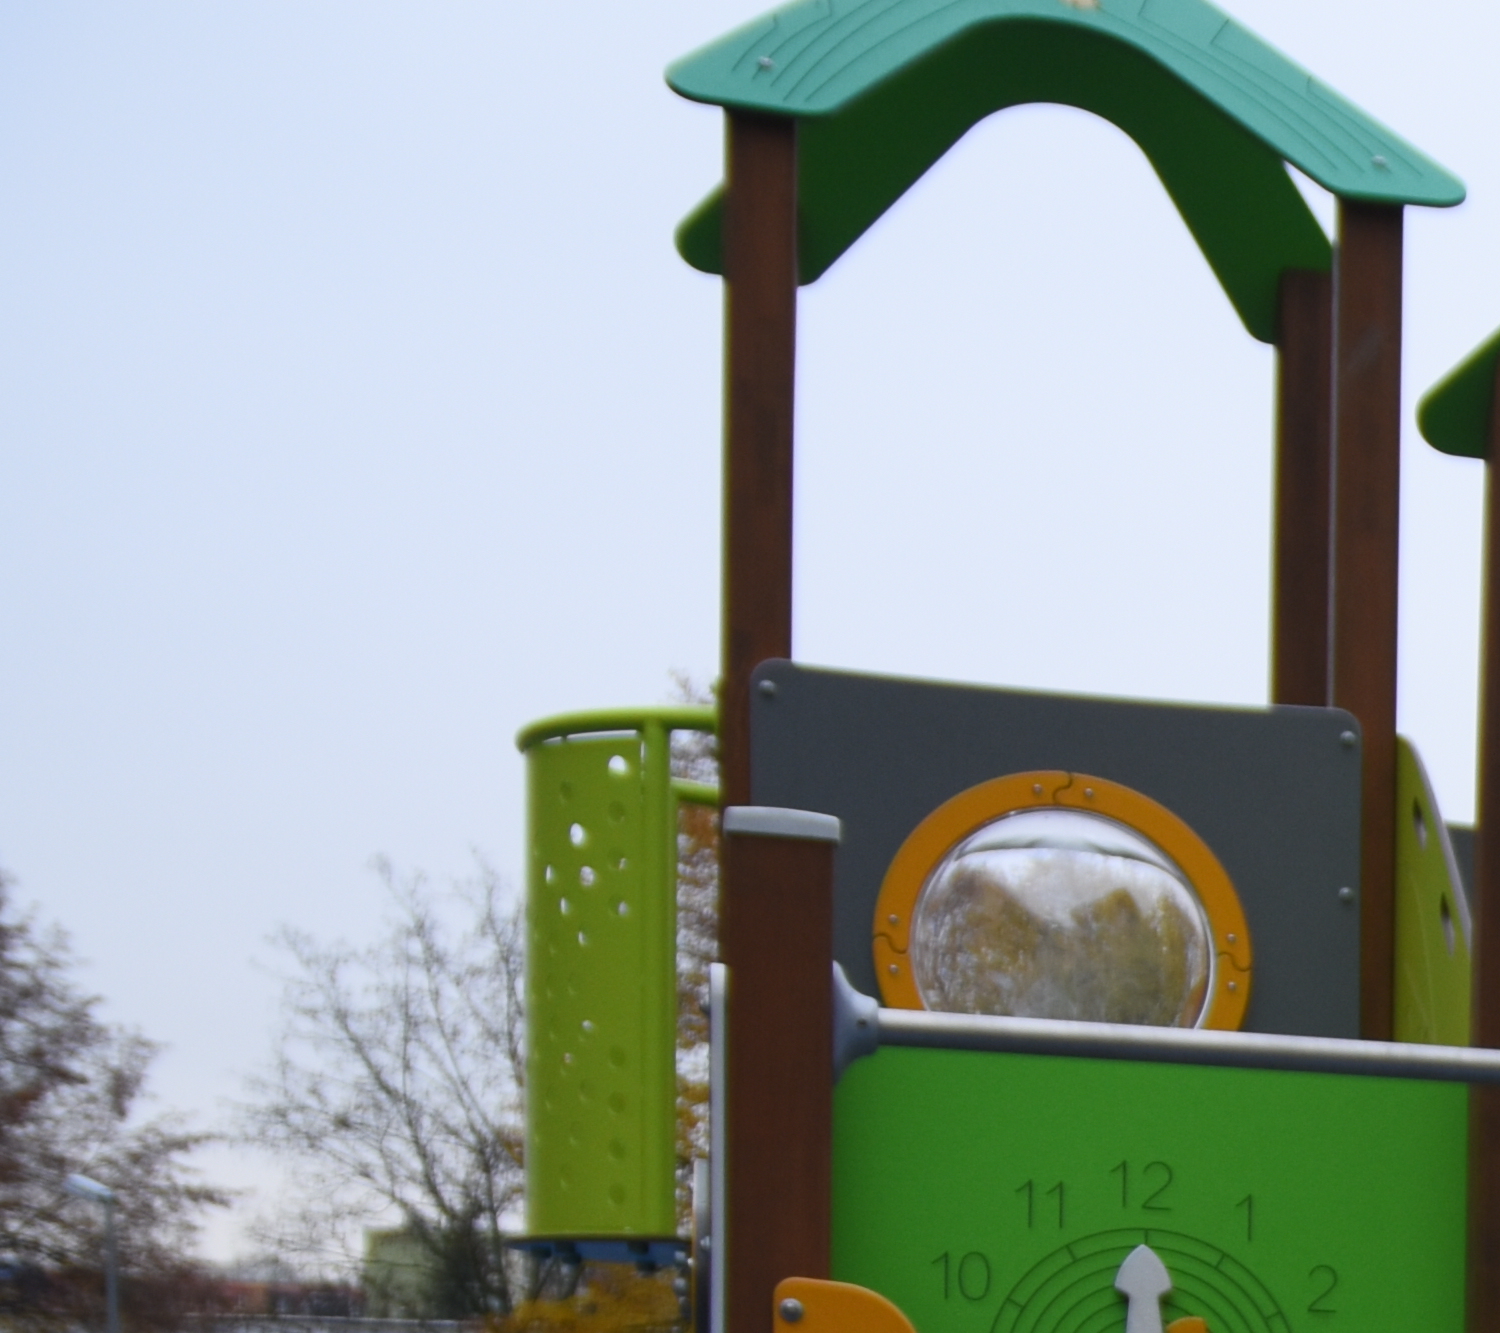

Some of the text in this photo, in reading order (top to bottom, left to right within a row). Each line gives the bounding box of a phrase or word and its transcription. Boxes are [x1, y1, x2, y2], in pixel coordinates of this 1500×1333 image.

[1014, 1179, 1066, 1229] 11
[1110, 1159, 1175, 1211] 12
[1235, 1194, 1254, 1242] 1
[931, 1250, 992, 1301] 10
[1307, 1264, 1338, 1314] 2
